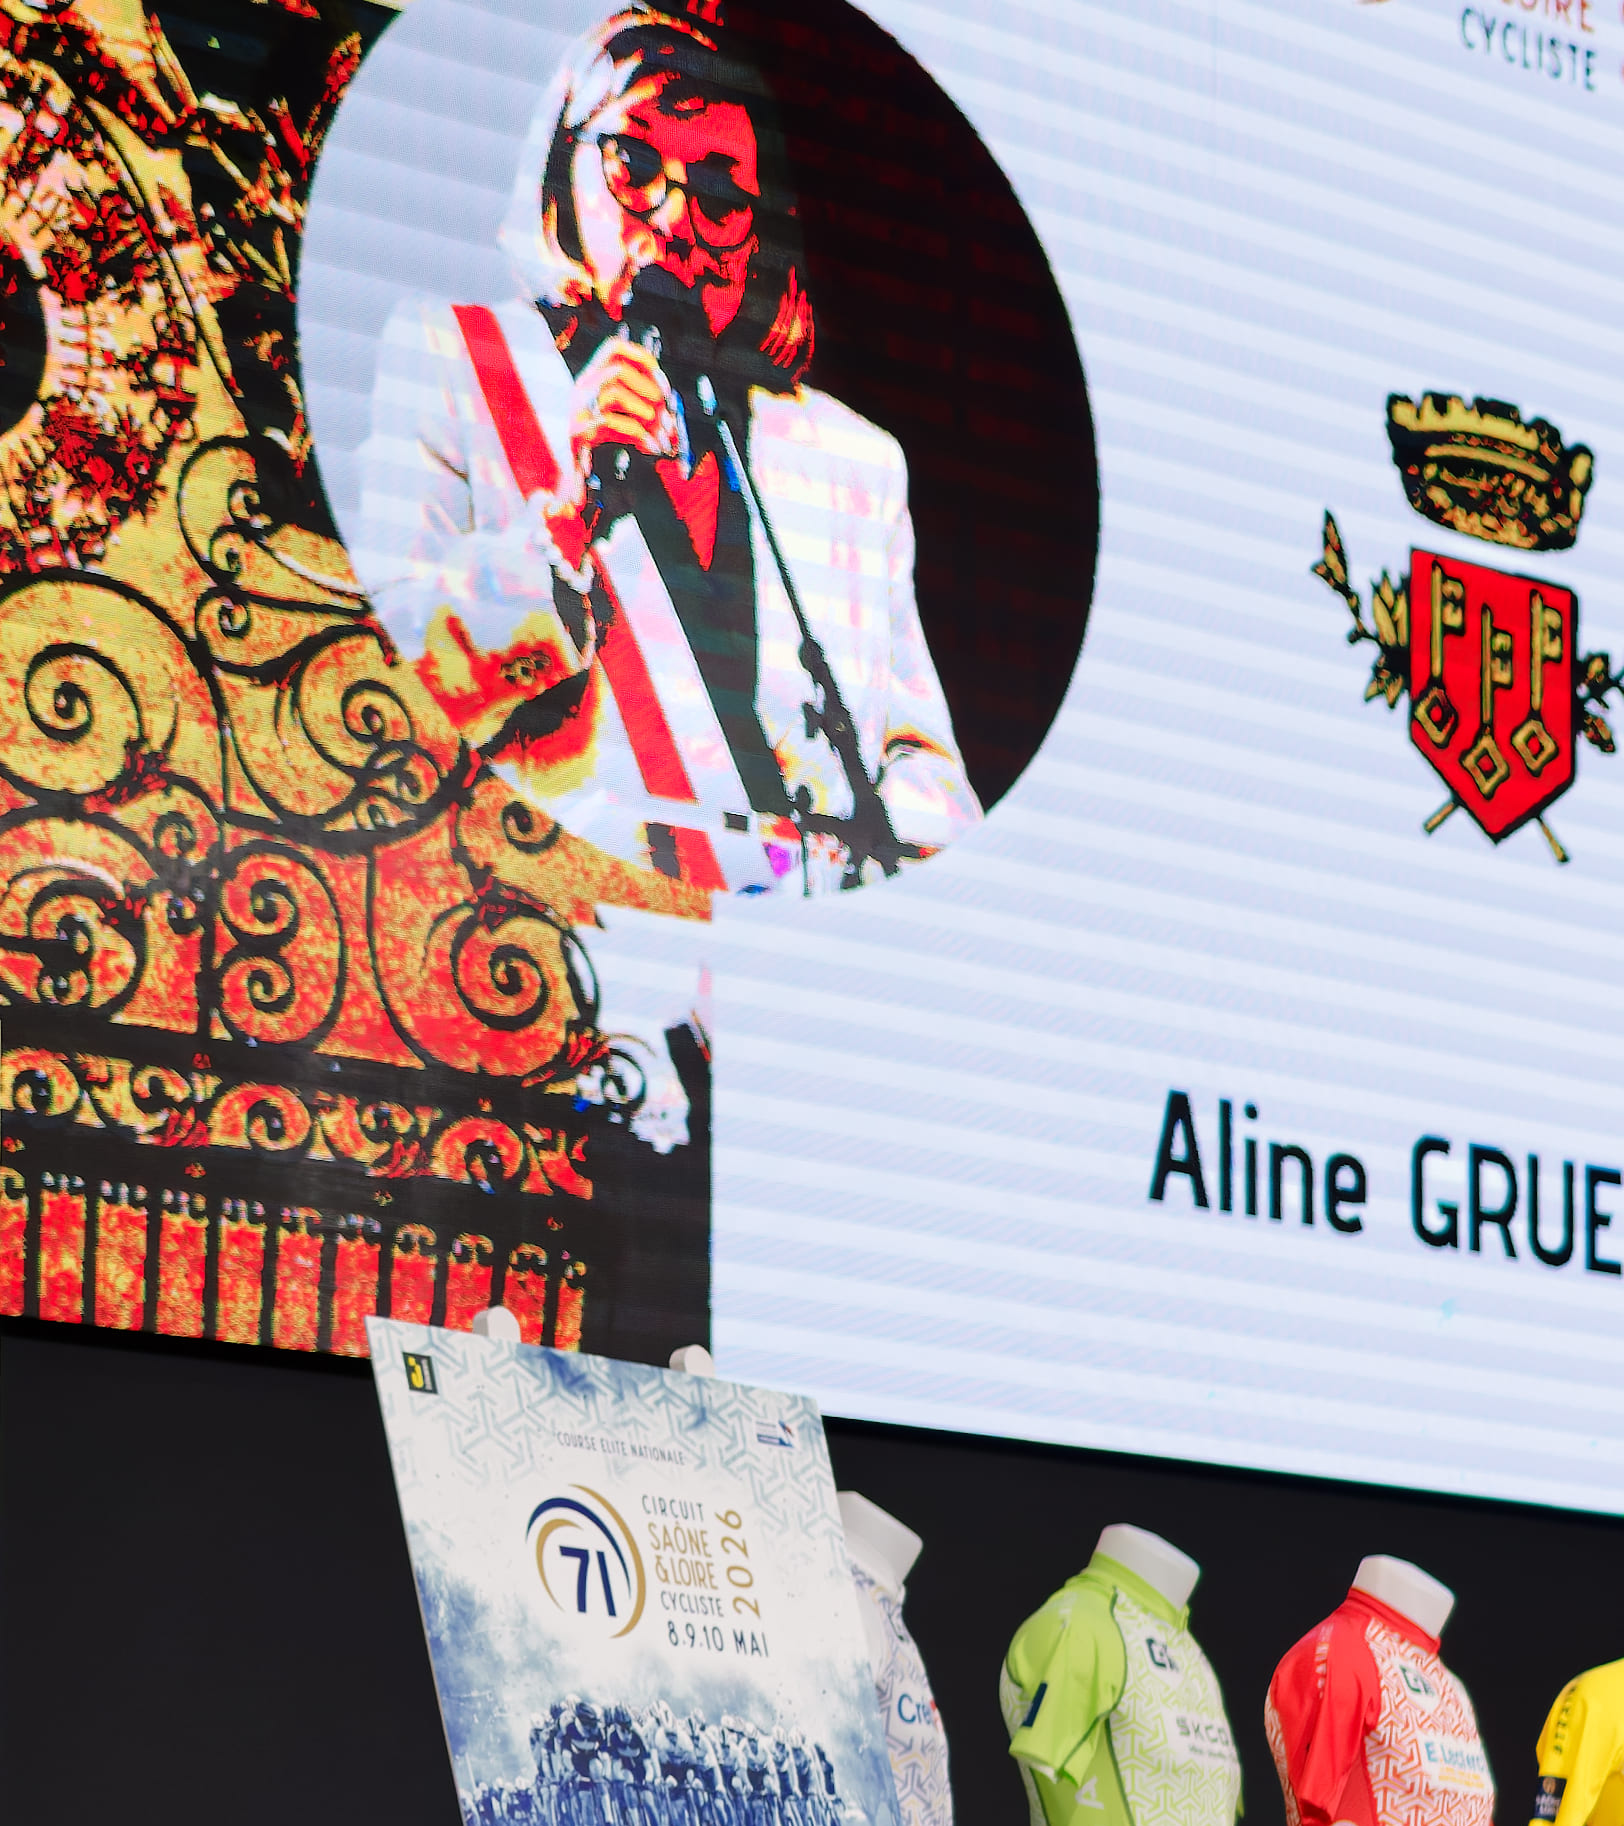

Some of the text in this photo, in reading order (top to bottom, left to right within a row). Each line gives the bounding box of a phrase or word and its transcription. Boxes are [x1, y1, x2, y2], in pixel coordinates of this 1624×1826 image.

[1461, 7, 1597, 92] CYCLISTE
[1148, 1088, 1369, 1234] Aline
[642, 1494, 704, 1522] CIRCUIT
[648, 1521, 712, 1558] SAÔNE
[714, 1509, 761, 1619] 2026
[660, 1590, 725, 1618] CYCLISTE
[732, 1628, 770, 1659] MAI
